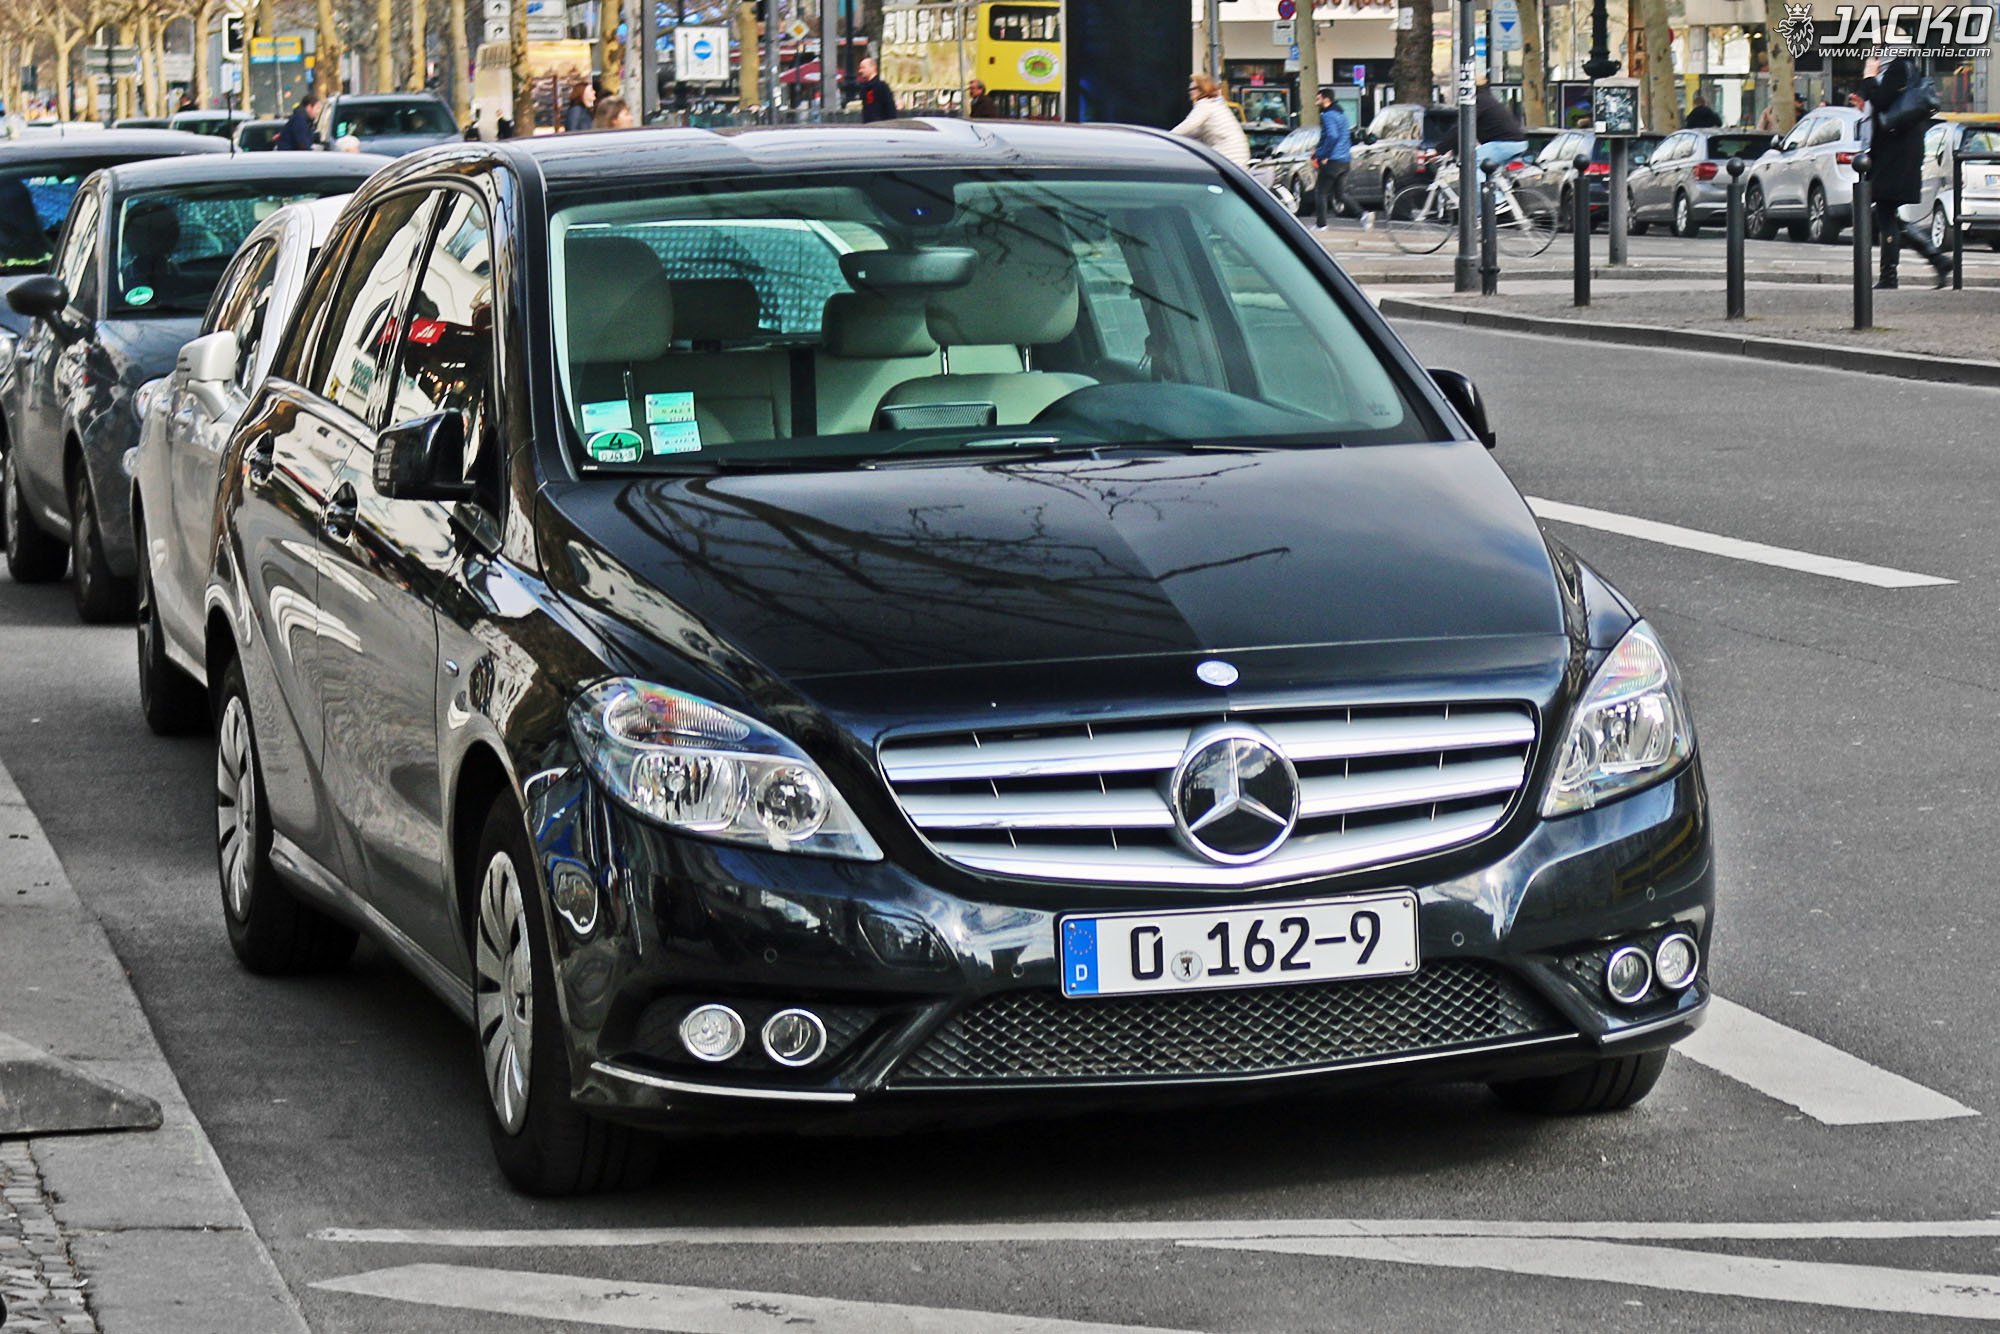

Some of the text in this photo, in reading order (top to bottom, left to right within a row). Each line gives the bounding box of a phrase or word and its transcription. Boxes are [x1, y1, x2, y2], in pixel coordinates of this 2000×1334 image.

[609, 433, 623, 449] 4
[1207, 910, 1381, 977] 162-9
[1075, 964, 1088, 981] D
